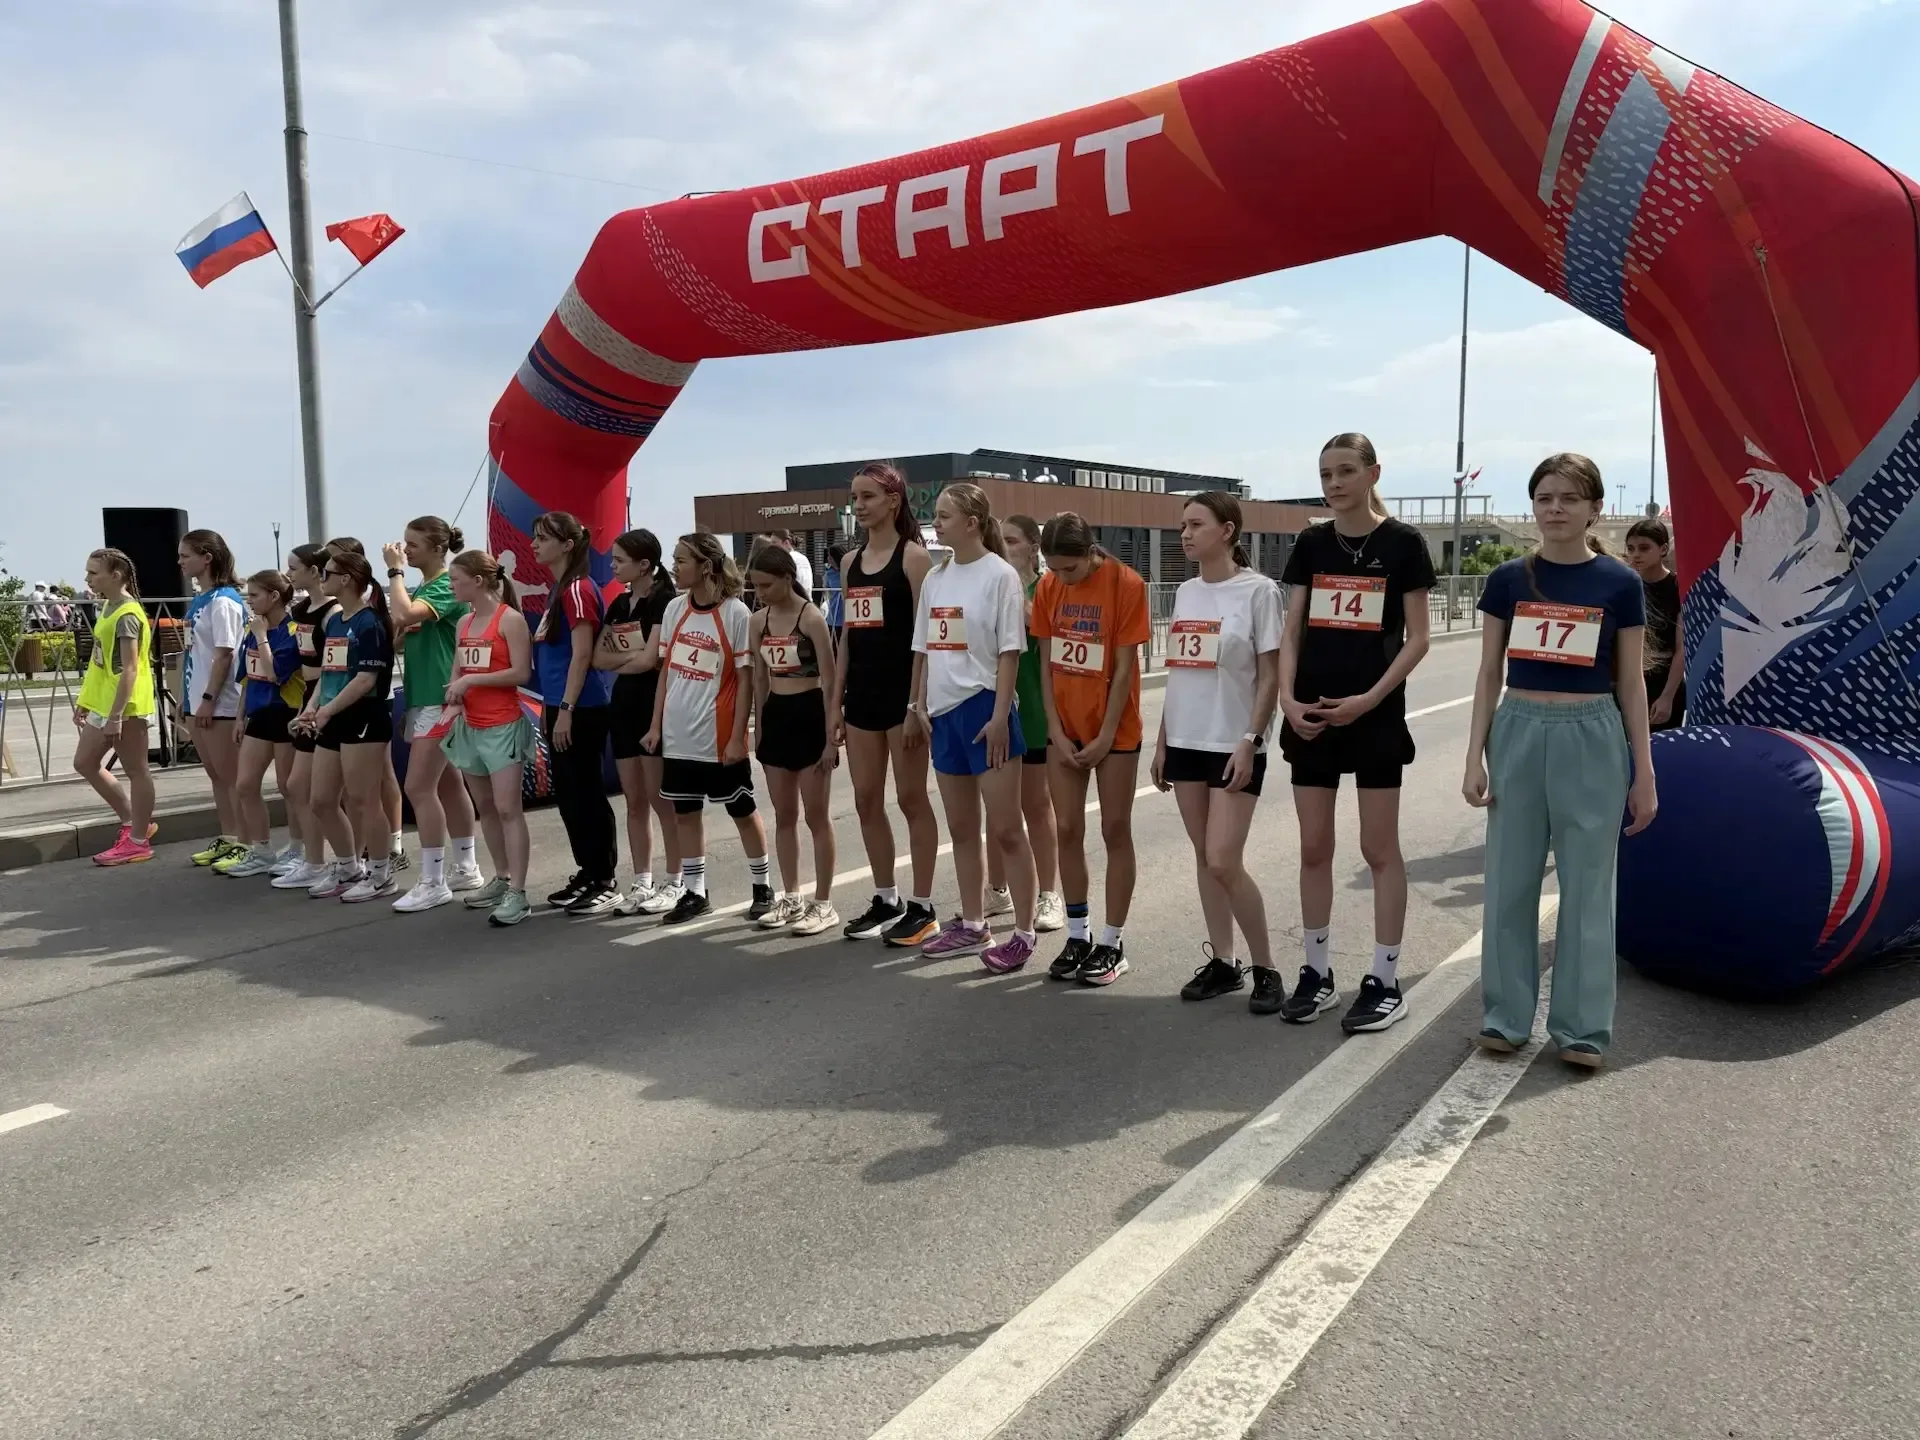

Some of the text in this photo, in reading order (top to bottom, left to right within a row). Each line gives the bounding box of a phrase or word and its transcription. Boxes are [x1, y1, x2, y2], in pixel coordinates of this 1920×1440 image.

[747, 114, 1165, 283] СТАРТ
[852, 599, 871, 618] 18
[1330, 591, 1363, 617] 14
[939, 620, 948, 640] 9
[1535, 620, 1576, 649] 17
[618, 634, 630, 649] 6
[1178, 634, 1201, 657] 13
[327, 648, 334, 663] 5
[464, 648, 480, 665] 10
[688, 649, 699, 666] 4
[768, 647, 787, 664] 12
[1061, 641, 1088, 664] 20
